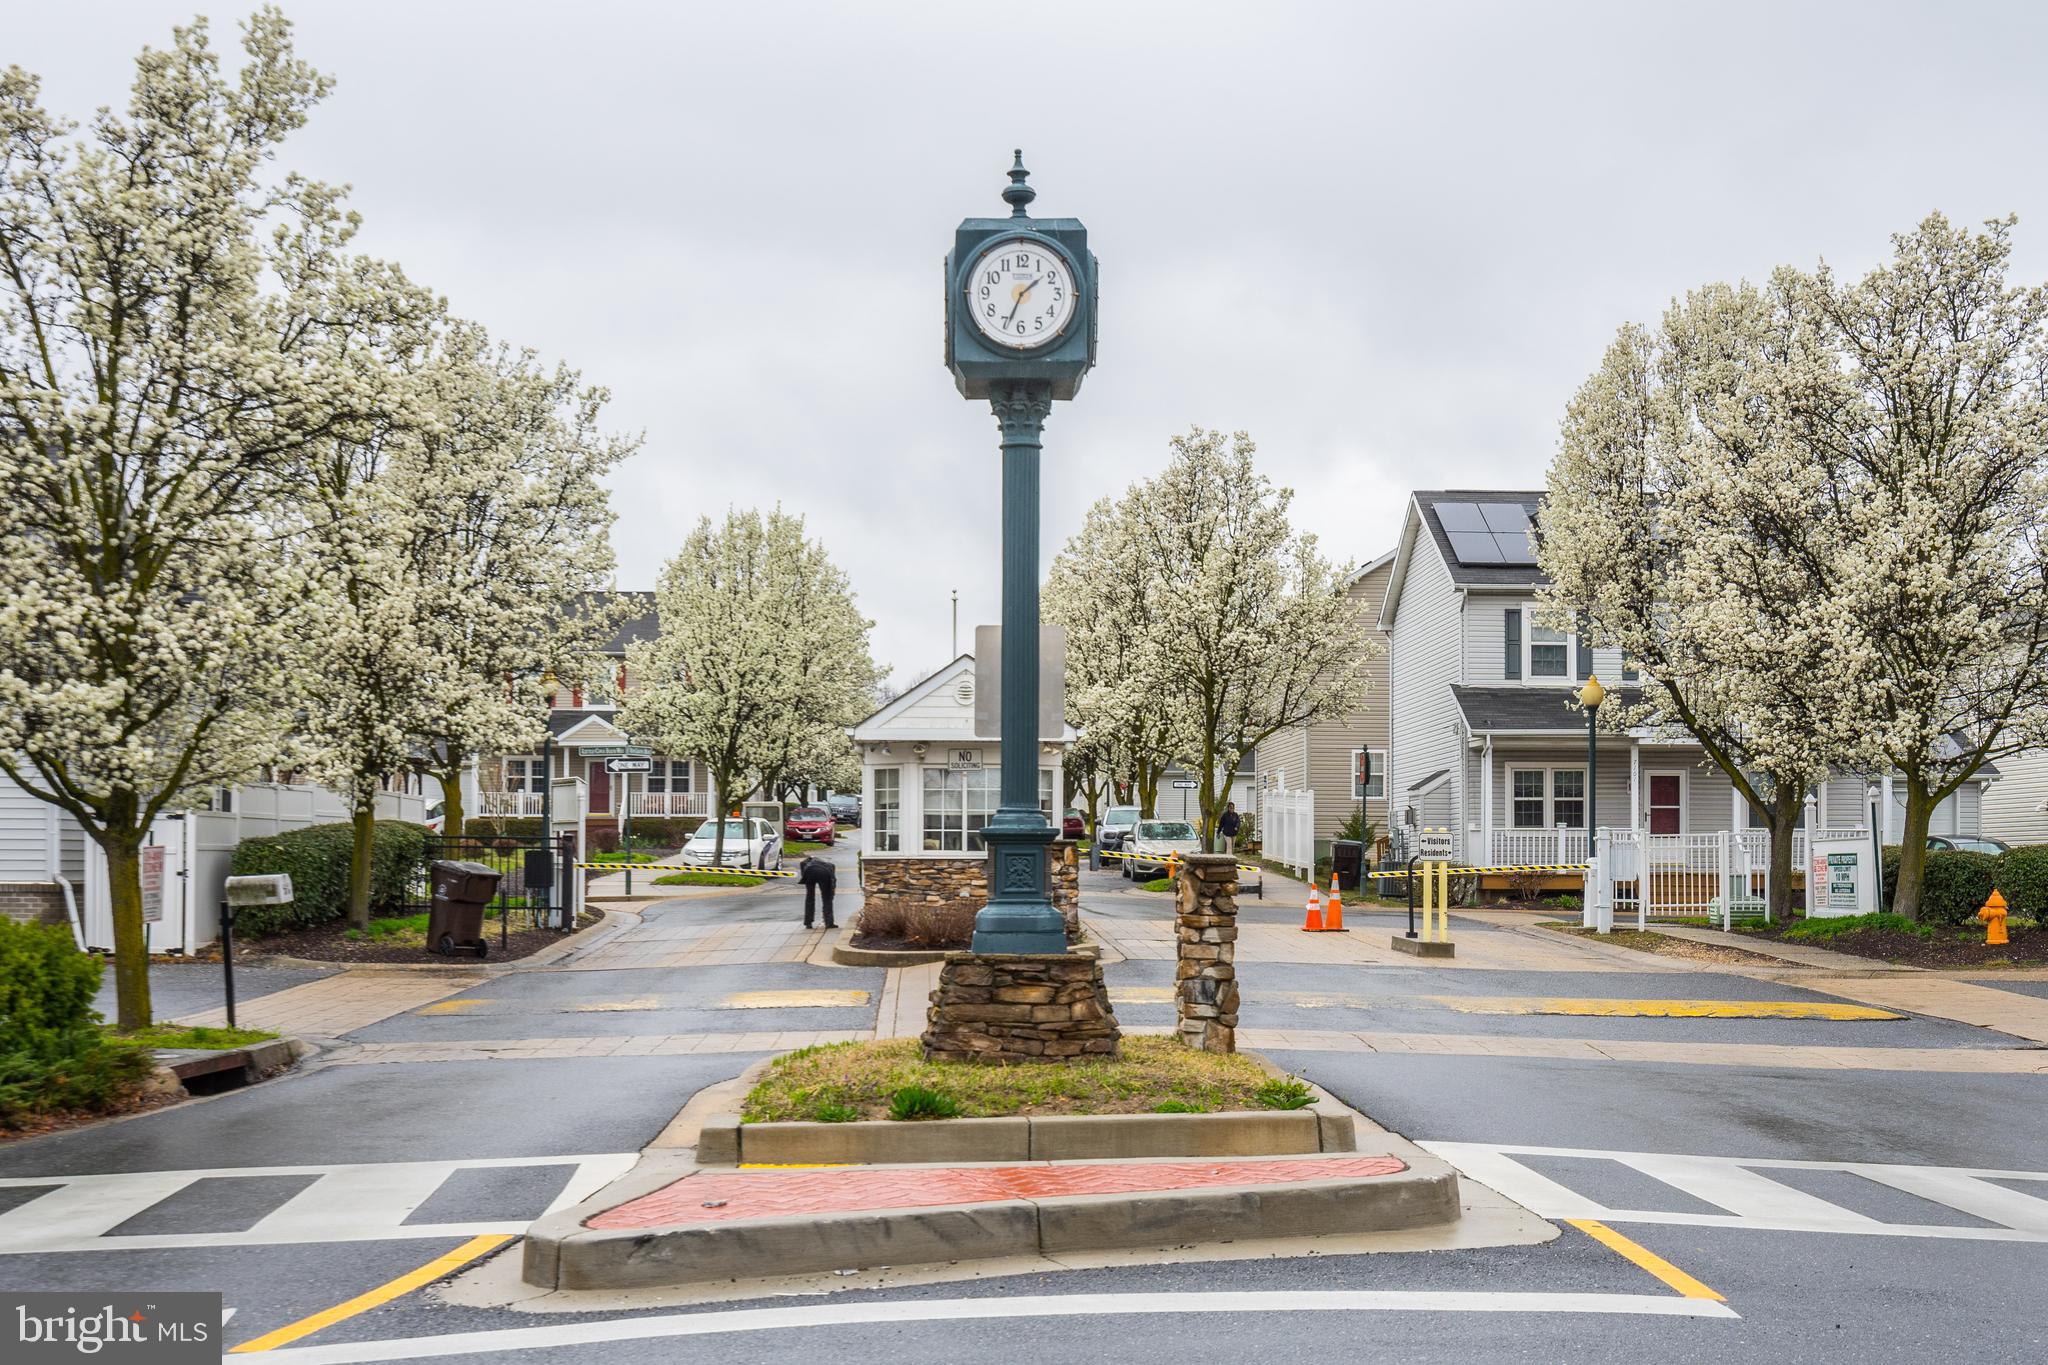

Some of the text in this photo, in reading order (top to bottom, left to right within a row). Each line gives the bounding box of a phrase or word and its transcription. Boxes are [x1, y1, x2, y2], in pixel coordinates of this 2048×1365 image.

[1000, 258, 1010, 272] 11
[1016, 254, 1029, 268] 12
[1036, 259, 1041, 272] 1
[986, 271, 1001, 285] 10
[1047, 271, 1056, 285] 2
[981, 286, 990, 300] 9
[1053, 287, 1062, 301] 3
[986, 303, 996, 317] 8
[1046, 304, 1055, 318] 4
[1001, 316, 1009, 330] 7
[1016, 320, 1026, 334] 6
[1034, 316, 1043, 330] 5
[959, 751, 972, 761] NO
[1420, 849, 1448, 857] Residents
[1841, 873, 1850, 881] MPH
